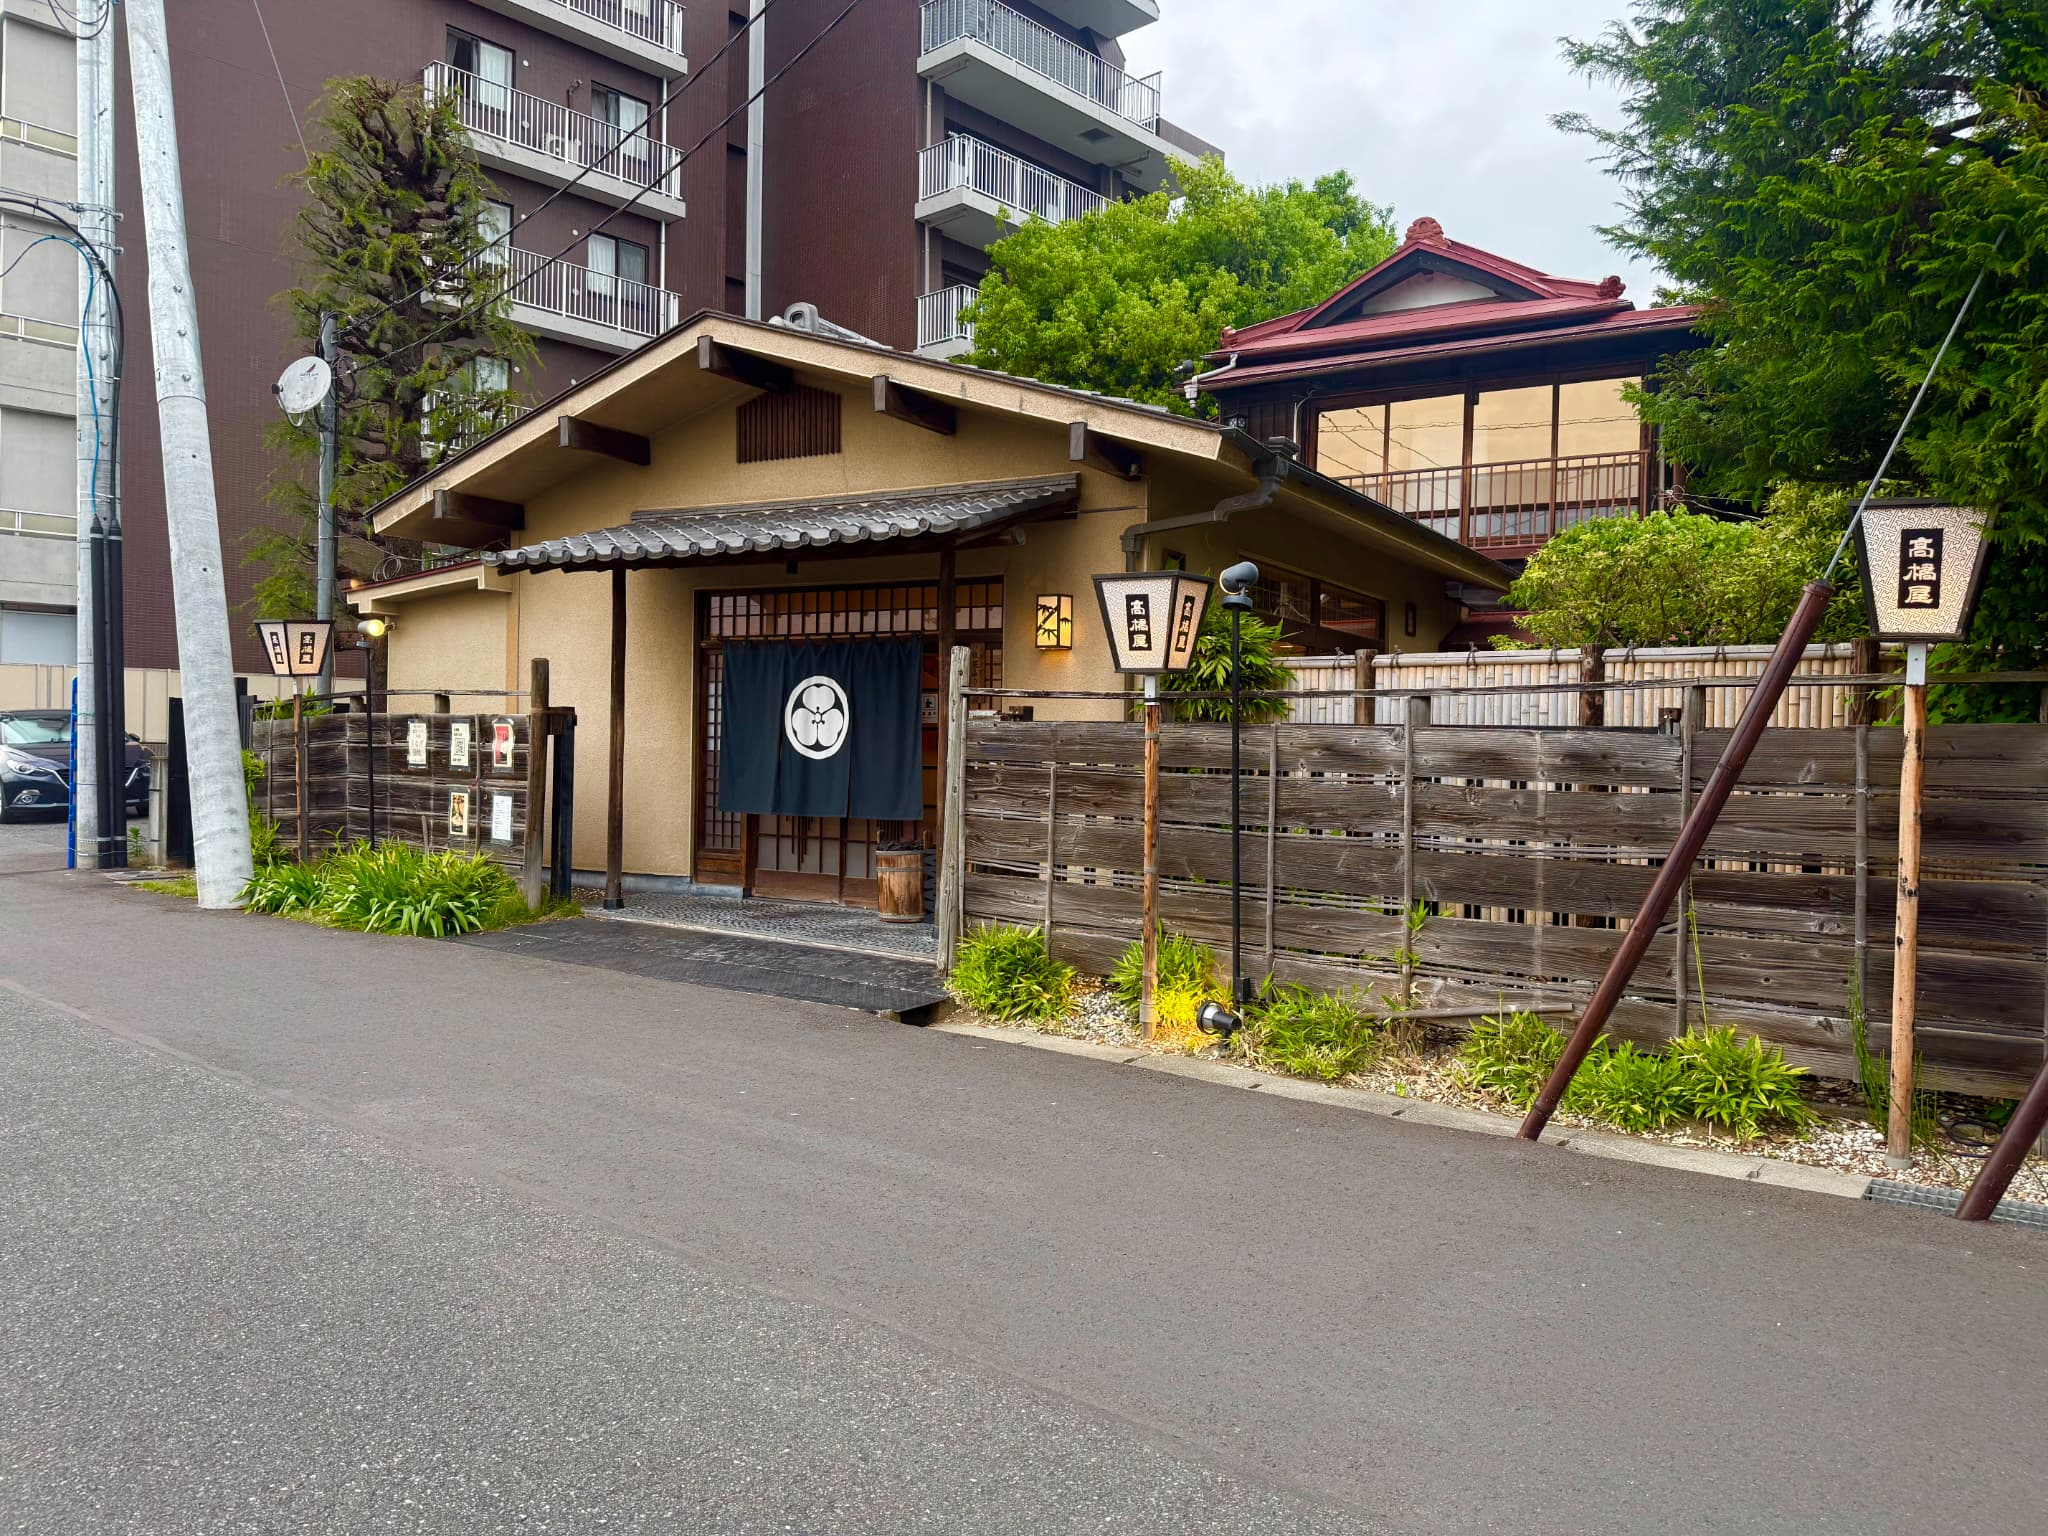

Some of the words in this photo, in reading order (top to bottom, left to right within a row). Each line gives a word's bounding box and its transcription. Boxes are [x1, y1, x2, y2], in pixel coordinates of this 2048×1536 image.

[1903, 536, 1937, 604] 高橋屋
[1129, 599, 1149, 648] 高橋屋
